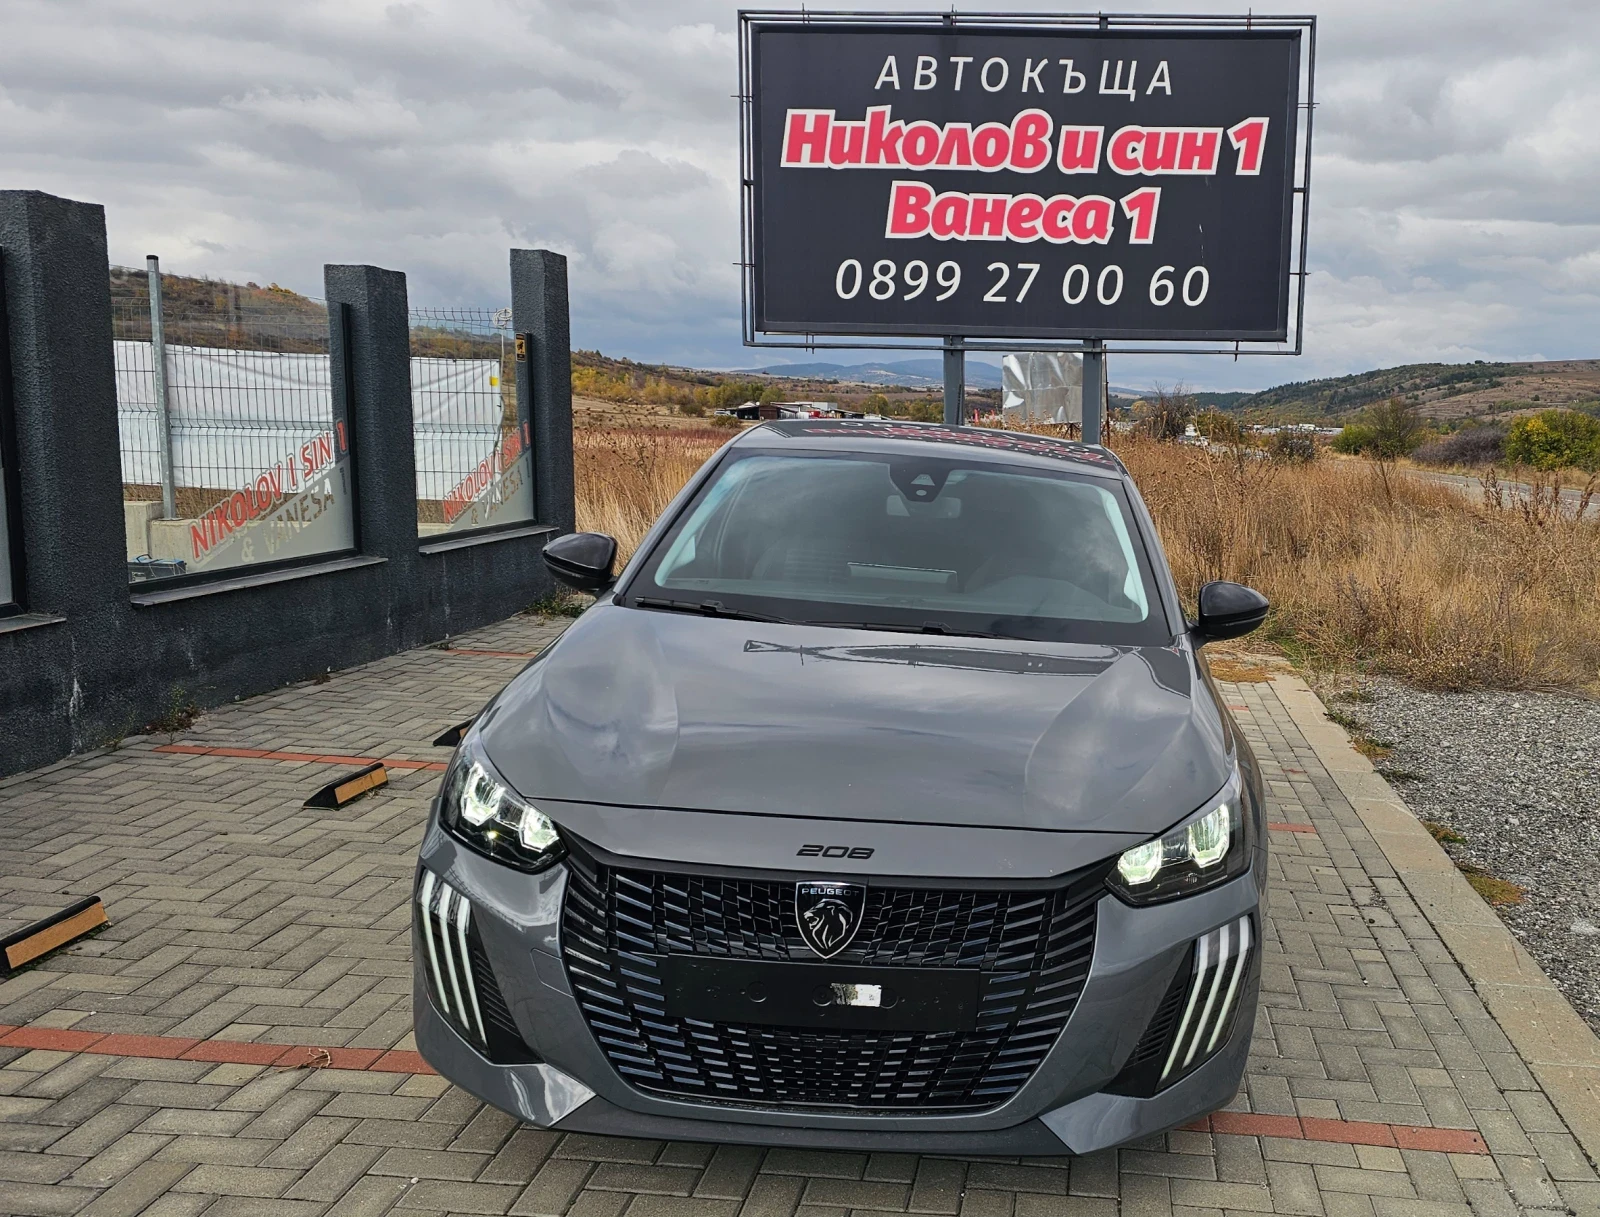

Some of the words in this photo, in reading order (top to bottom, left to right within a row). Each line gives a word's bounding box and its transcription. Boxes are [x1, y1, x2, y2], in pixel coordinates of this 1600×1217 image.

[874, 55, 1172, 102] АВТОКЪЩА
[780, 105, 1053, 173] Николов
[1057, 125, 1104, 174] и
[1107, 125, 1223, 176] син
[1227, 117, 1269, 175] 1
[885, 181, 1115, 244] Ванеса
[1119, 187, 1161, 244] 1
[836, 259, 962, 302] 0899
[983, 262, 1041, 304] 27
[1063, 264, 1124, 306] 00
[1150, 265, 1210, 307] 60
[189, 461, 283, 563] NIKOLOV
[300, 430, 335, 482] SIN
[442, 450, 494, 524] NIKOLOV
[240, 536, 255, 563] &
[262, 477, 336, 555] VANESA
[796, 844, 875, 860] 208
[801, 887, 860, 897] PEUGEOT
